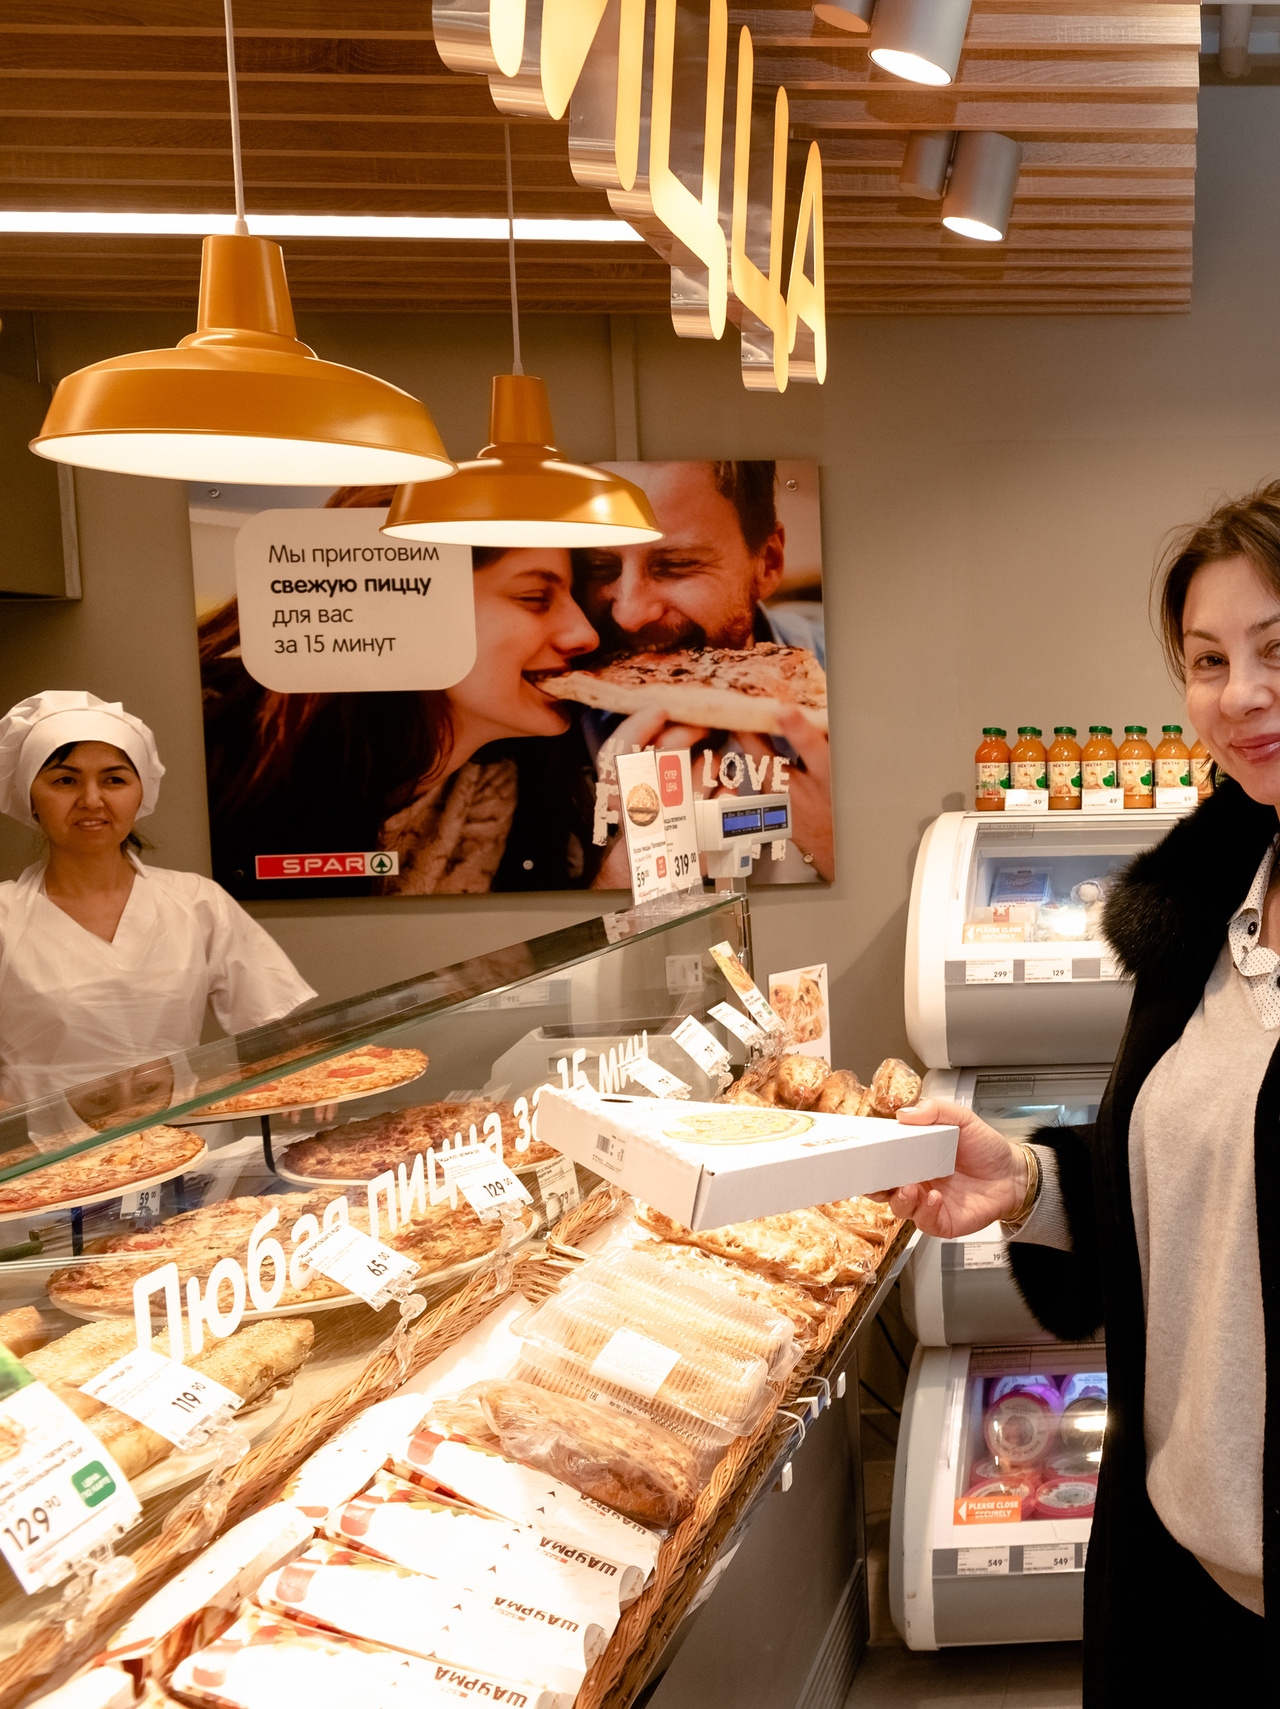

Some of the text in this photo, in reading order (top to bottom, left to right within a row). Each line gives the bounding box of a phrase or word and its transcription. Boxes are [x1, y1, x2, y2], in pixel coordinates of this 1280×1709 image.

[268, 545, 440, 567] Мы приготовим
[270, 578, 432, 598] свежую пиццу
[272, 608, 354, 628] для вас
[274, 634, 397, 657] за 15 минут
[703, 749, 791, 793] LOVE
[282, 857, 364, 874] SPAR
[674, 854, 689, 877] 319
[690, 852, 697, 863] 00
[637, 871, 645, 888] 59
[482, 1177, 513, 1198] 129 00
[134, 1194, 350, 1363] Любая
[556, 1047, 588, 1090] 15
[139, 1192, 149, 1206] 59
[366, 1259, 389, 1277] 65
[171, 1382, 206, 1413] 119 90
[80, 1474, 111, 1500] ПО КАРТЕ
[82, 1473, 101, 1488] ЦЕНА
[580, 1493, 647, 1536] ШАУРМА
[968, 1501, 1019, 1510] PLEASE CLOSE
[975, 1510, 1011, 1519] SECURELY
[2, 1495, 62, 1552] 129 90
[539, 1536, 618, 1577] ШАУРМА
[988, 1559, 1003, 1567] 549
[1053, 1558, 1068, 1566] 549
[494, 1596, 579, 1633] ШАУРМА
[434, 1666, 528, 1709] ШАУРМА
